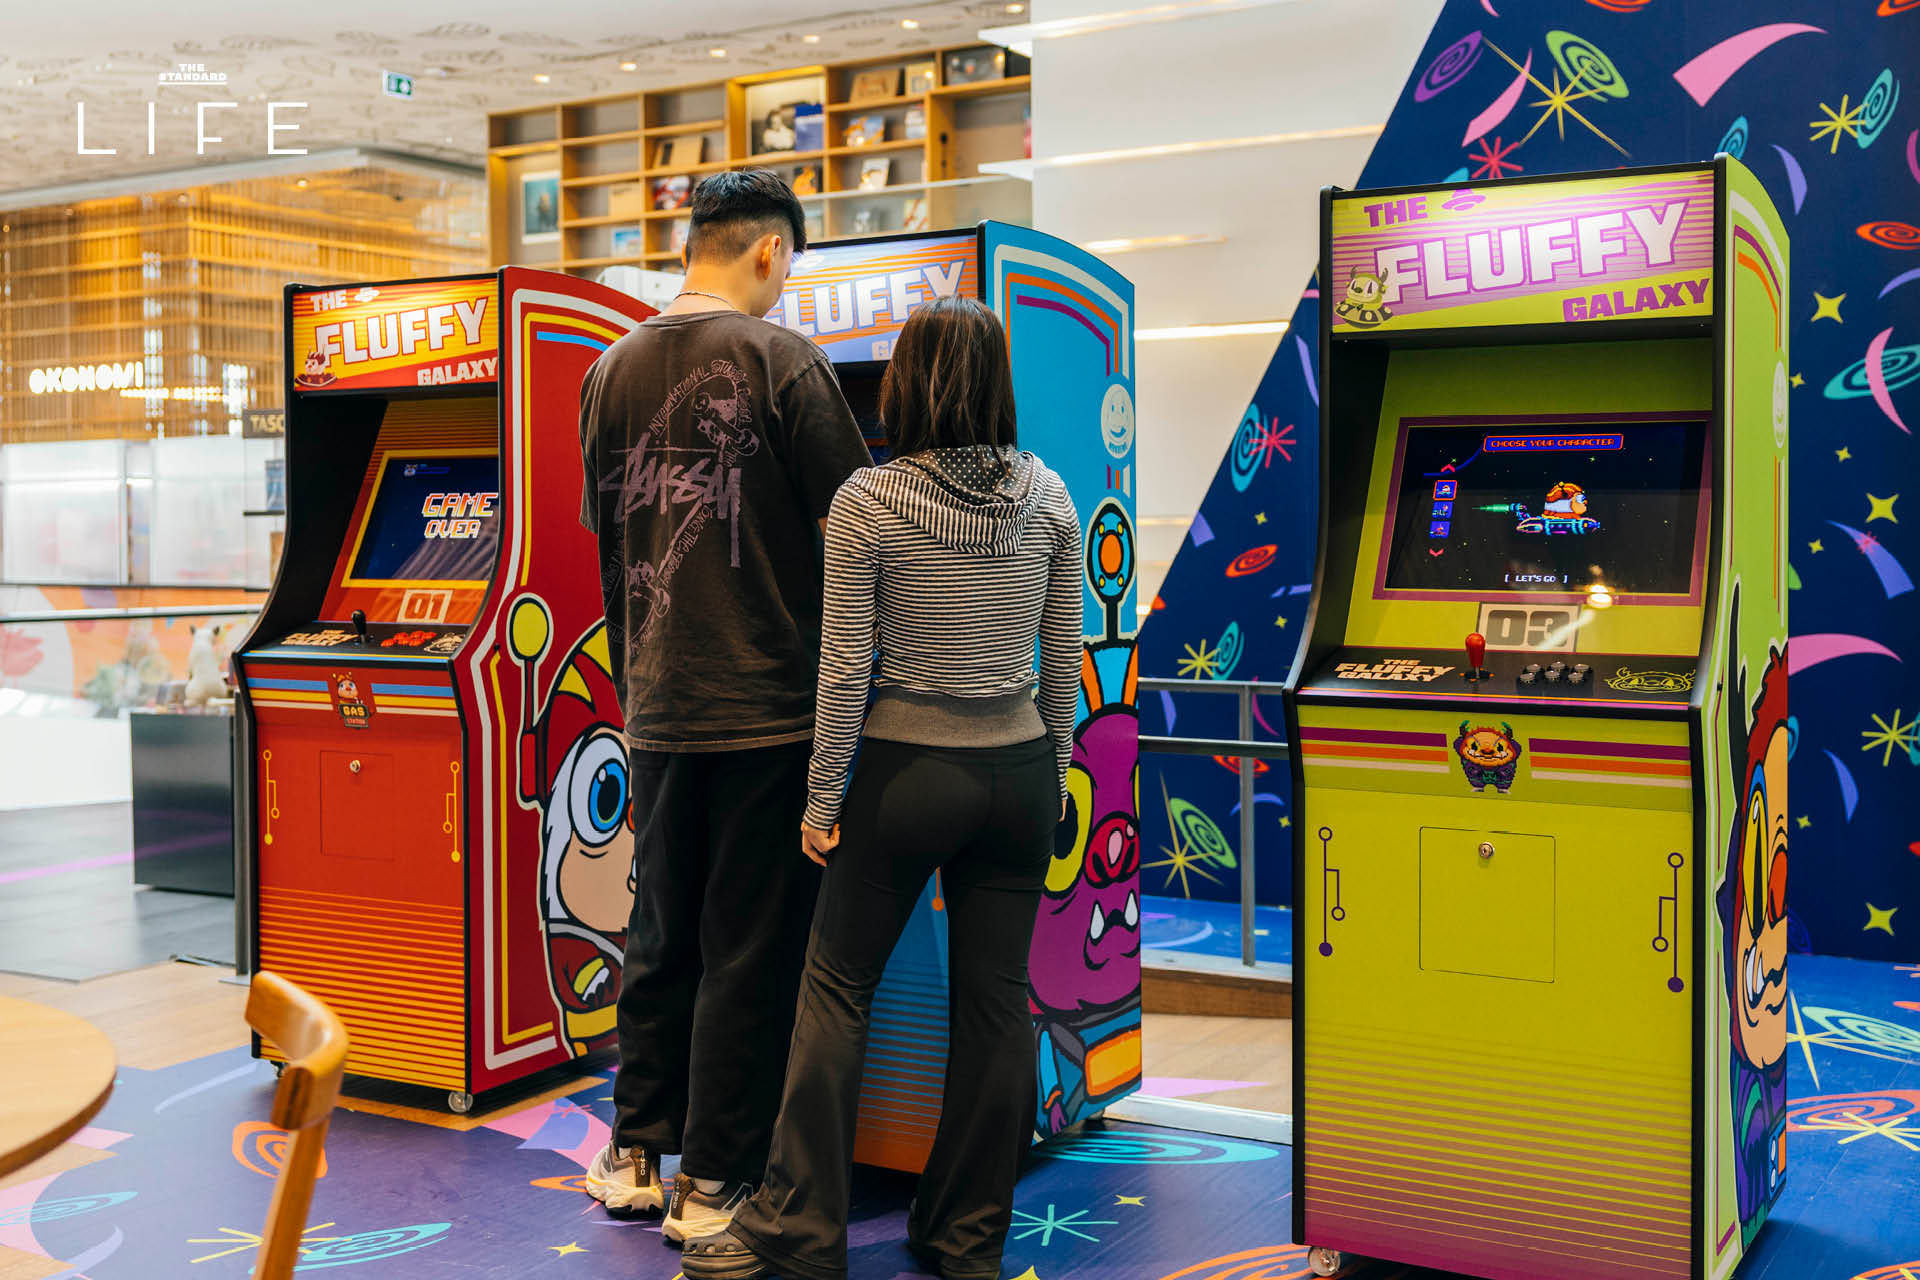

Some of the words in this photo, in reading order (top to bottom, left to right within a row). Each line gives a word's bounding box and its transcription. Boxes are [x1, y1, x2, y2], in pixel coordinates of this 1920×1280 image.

[1364, 196, 1428, 228] THE
[1373, 200, 1691, 305] FLUFFY
[310, 290, 348, 312] THE
[763, 258, 966, 338] LUFFY
[1562, 278, 1710, 323] GALAXY
[314, 296, 489, 368] FLUFFY
[417, 357, 498, 386] GALAXY
[1490, 440, 1528, 448] CHOOSE
[1530, 439, 1555, 447] YOUR
[1557, 438, 1615, 447] CHARACTER
[422, 493, 499, 517] GAME
[424, 520, 481, 538] OVER
[1543, 575, 1557, 583] GO
[404, 593, 445, 620] 01
[1486, 609, 1571, 647] 03
[1334, 663, 1456, 676] FLUFFY
[1383, 658, 1421, 666] THE
[1337, 671, 1441, 682] GALAXY
